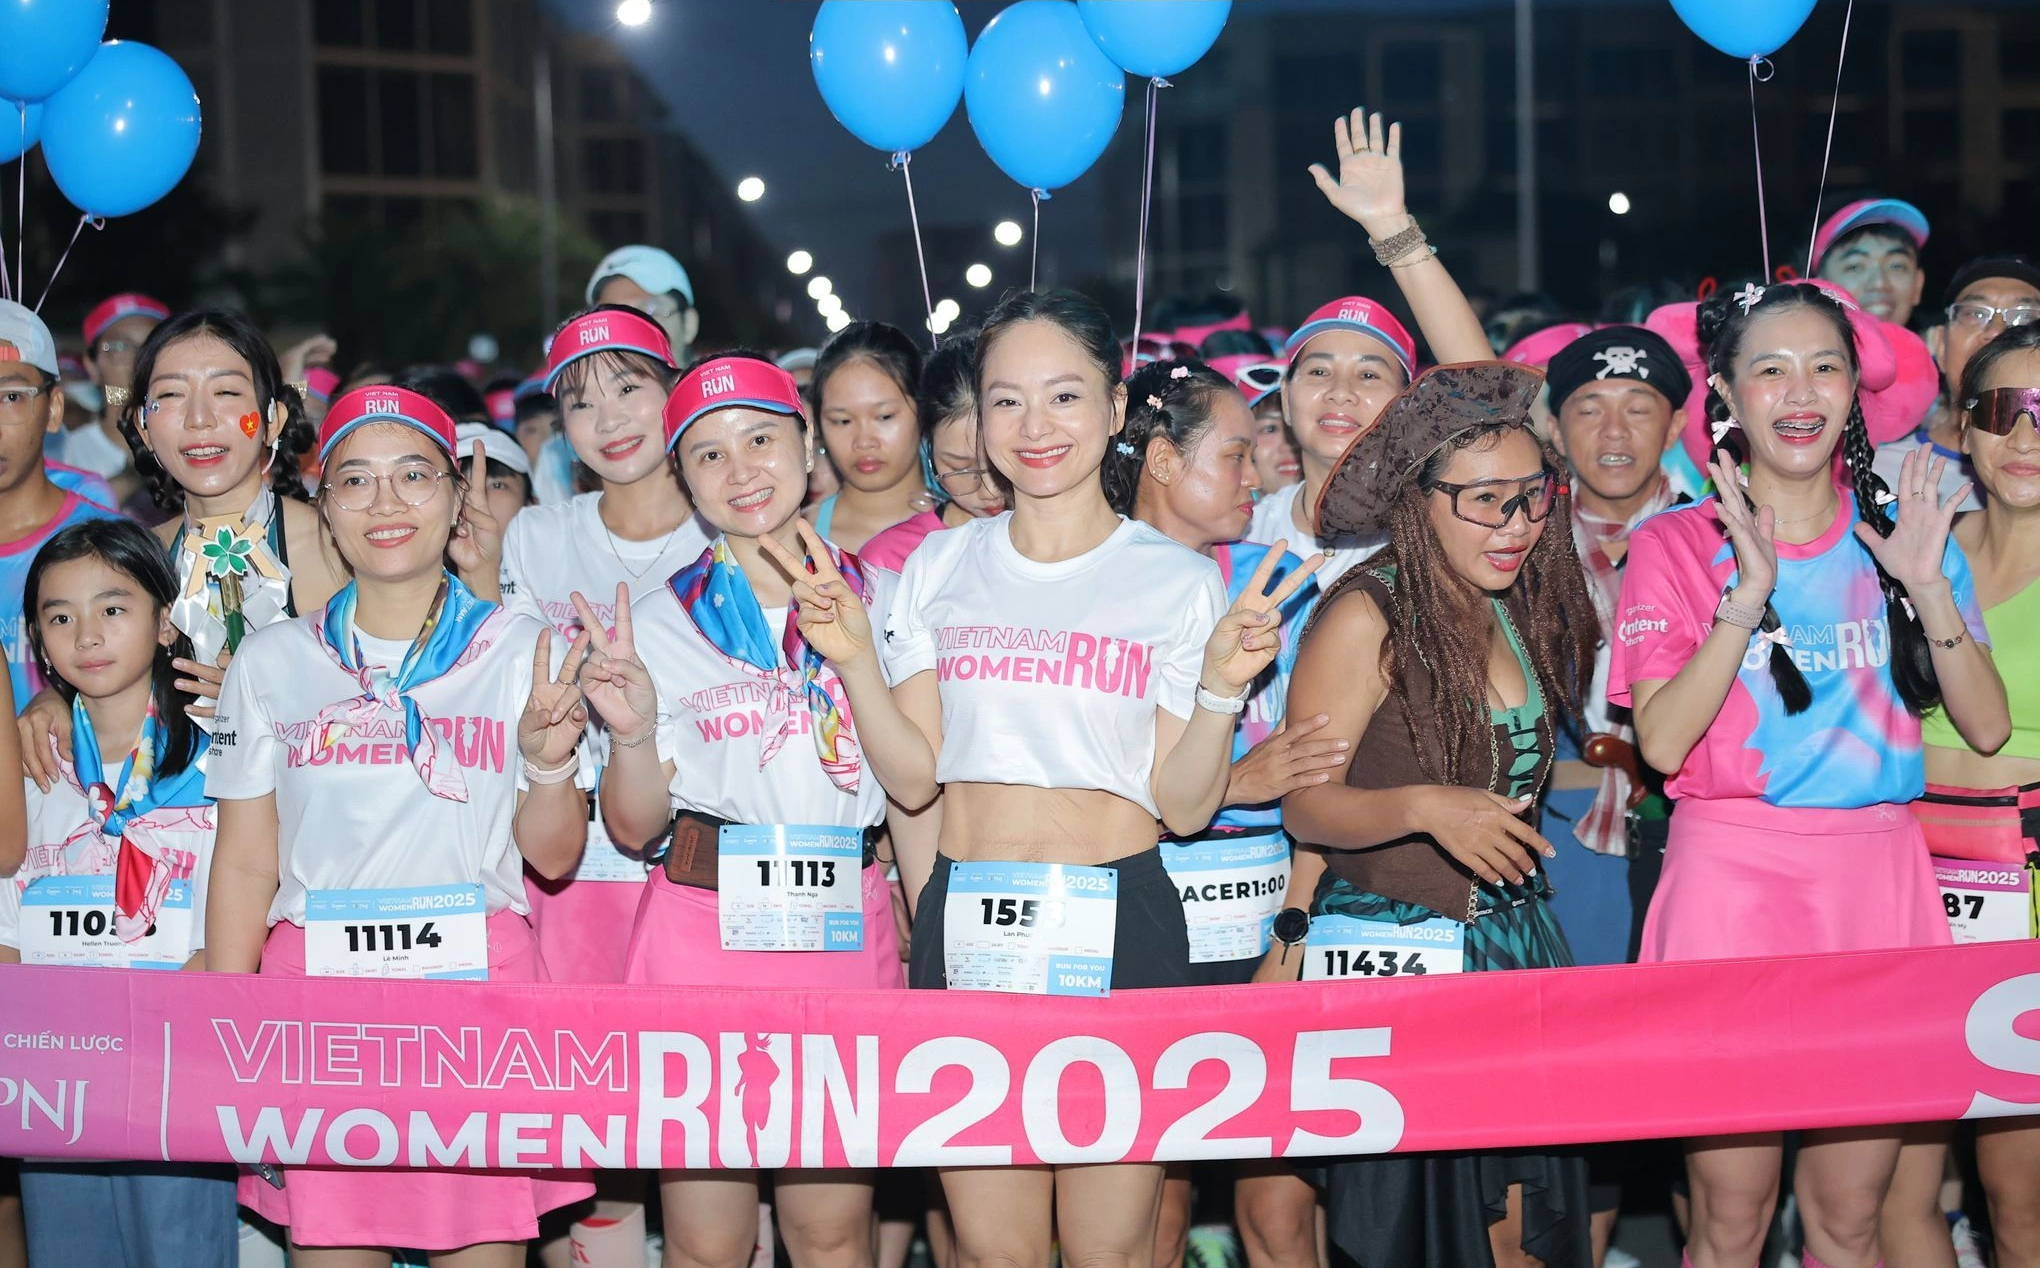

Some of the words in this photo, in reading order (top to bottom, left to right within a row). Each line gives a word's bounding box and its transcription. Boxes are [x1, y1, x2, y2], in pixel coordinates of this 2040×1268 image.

[1338, 308, 1369, 324] RUN
[579, 326, 610, 346] RUN
[715, 364, 732, 373] NAM
[701, 374, 735, 399] RUN
[365, 400, 400, 414] RUN
[935, 626, 1067, 653] VIETNAM
[1618, 618, 1668, 642] Cntent
[1836, 615, 1891, 669] RU
[936, 654, 1062, 685] WOMEN
[1063, 631, 1154, 699] RUN
[680, 682, 772, 713] VIETN
[835, 836, 857, 850] 2025
[1012, 878, 1045, 887] WOMEN
[1067, 875, 1109, 891] 2025
[1959, 869, 1978, 884] RUN
[1978, 870, 2020, 886] 2025
[91, 891, 115, 899] WOM
[1182, 874, 1285, 903] ACER1:00
[379, 903, 413, 912] WOMEN
[413, 896, 434, 910] RUN
[434, 892, 476, 909] 2025
[50, 910, 157, 937] 110
[344, 922, 442, 952] 11114
[831, 930, 858, 943] 10KM
[1361, 930, 1394, 939] WOMEN
[1394, 925, 1414, 940] RUN
[1414, 926, 1455, 943] 2025
[393, 954, 410, 962] Minh
[1073, 963, 1088, 971] FOR
[1325, 950, 1427, 976] 11434
[1058, 974, 1102, 989] 10KM
[3, 1030, 64, 1050] CHIẾN
[70, 1034, 124, 1055] LƯỢC
[211, 1018, 628, 1092] VIETNAM
[215, 1105, 628, 1168] WOMEN
[636, 1031, 880, 1169] RUN
[891, 1026, 1405, 1167] 2025
